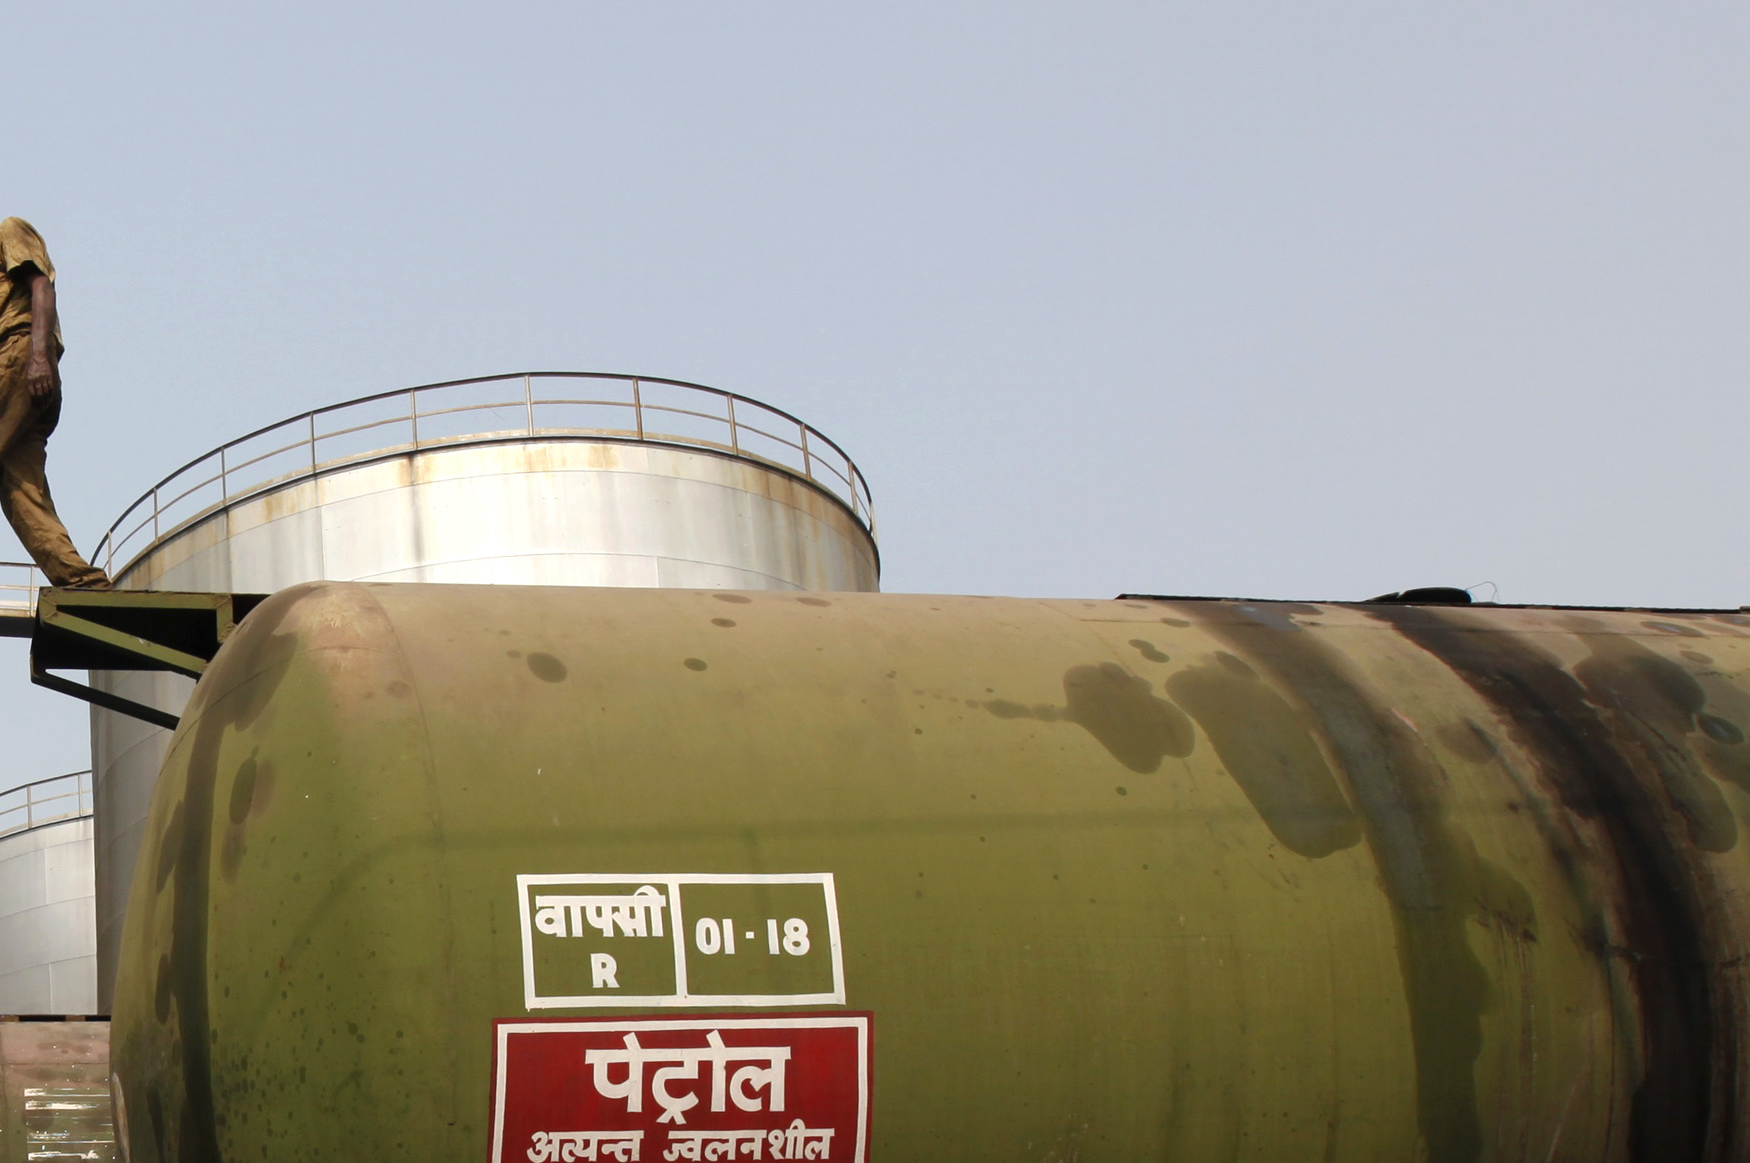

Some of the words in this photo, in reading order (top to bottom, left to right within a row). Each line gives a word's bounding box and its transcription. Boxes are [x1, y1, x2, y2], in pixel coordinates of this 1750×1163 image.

[591, 953, 619, 988] R
[585, 1030, 791, 1124] पेट्रोल
[526, 1130, 644, 1163] अत्यन्त
[662, 1118, 835, 1162] ज्वलनशील
